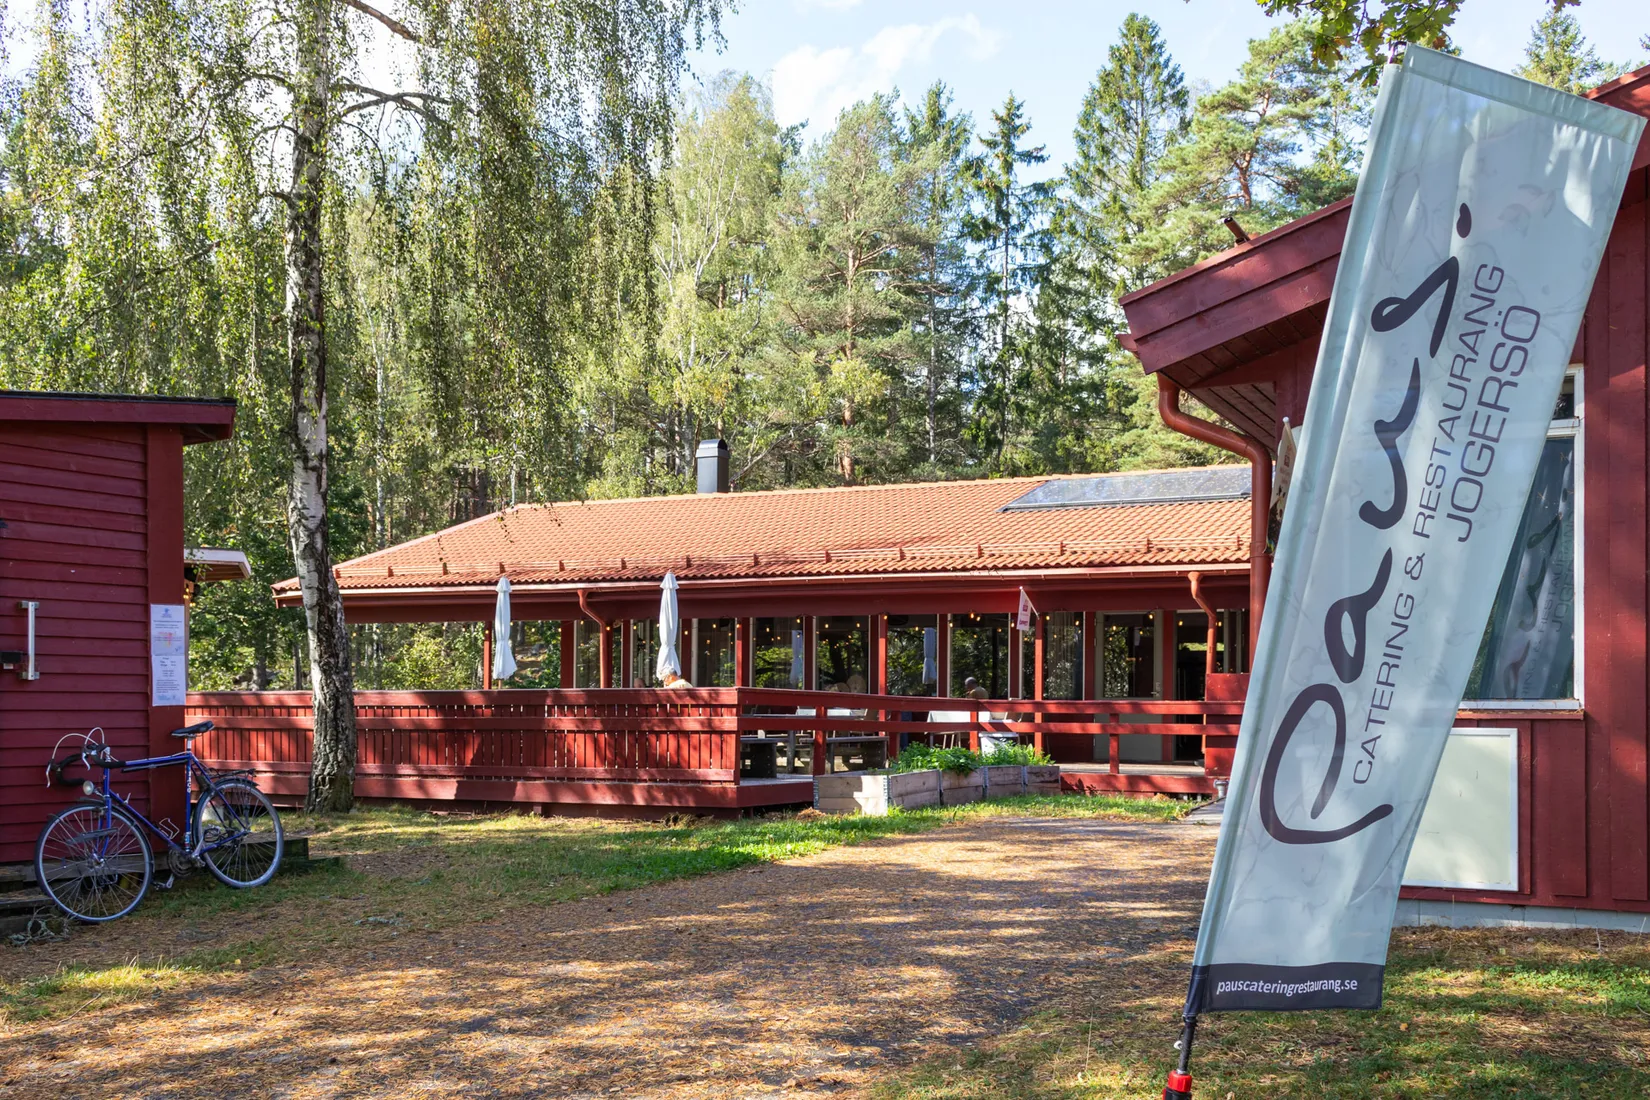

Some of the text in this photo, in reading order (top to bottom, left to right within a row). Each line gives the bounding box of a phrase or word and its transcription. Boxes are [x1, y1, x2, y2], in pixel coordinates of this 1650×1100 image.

[1353, 263, 1505, 785] CATERING & RESTAURANG
[1447, 305, 1541, 542] JOGERSÖ
[1216, 979, 1357, 996] pauscateringrestaurang.se
